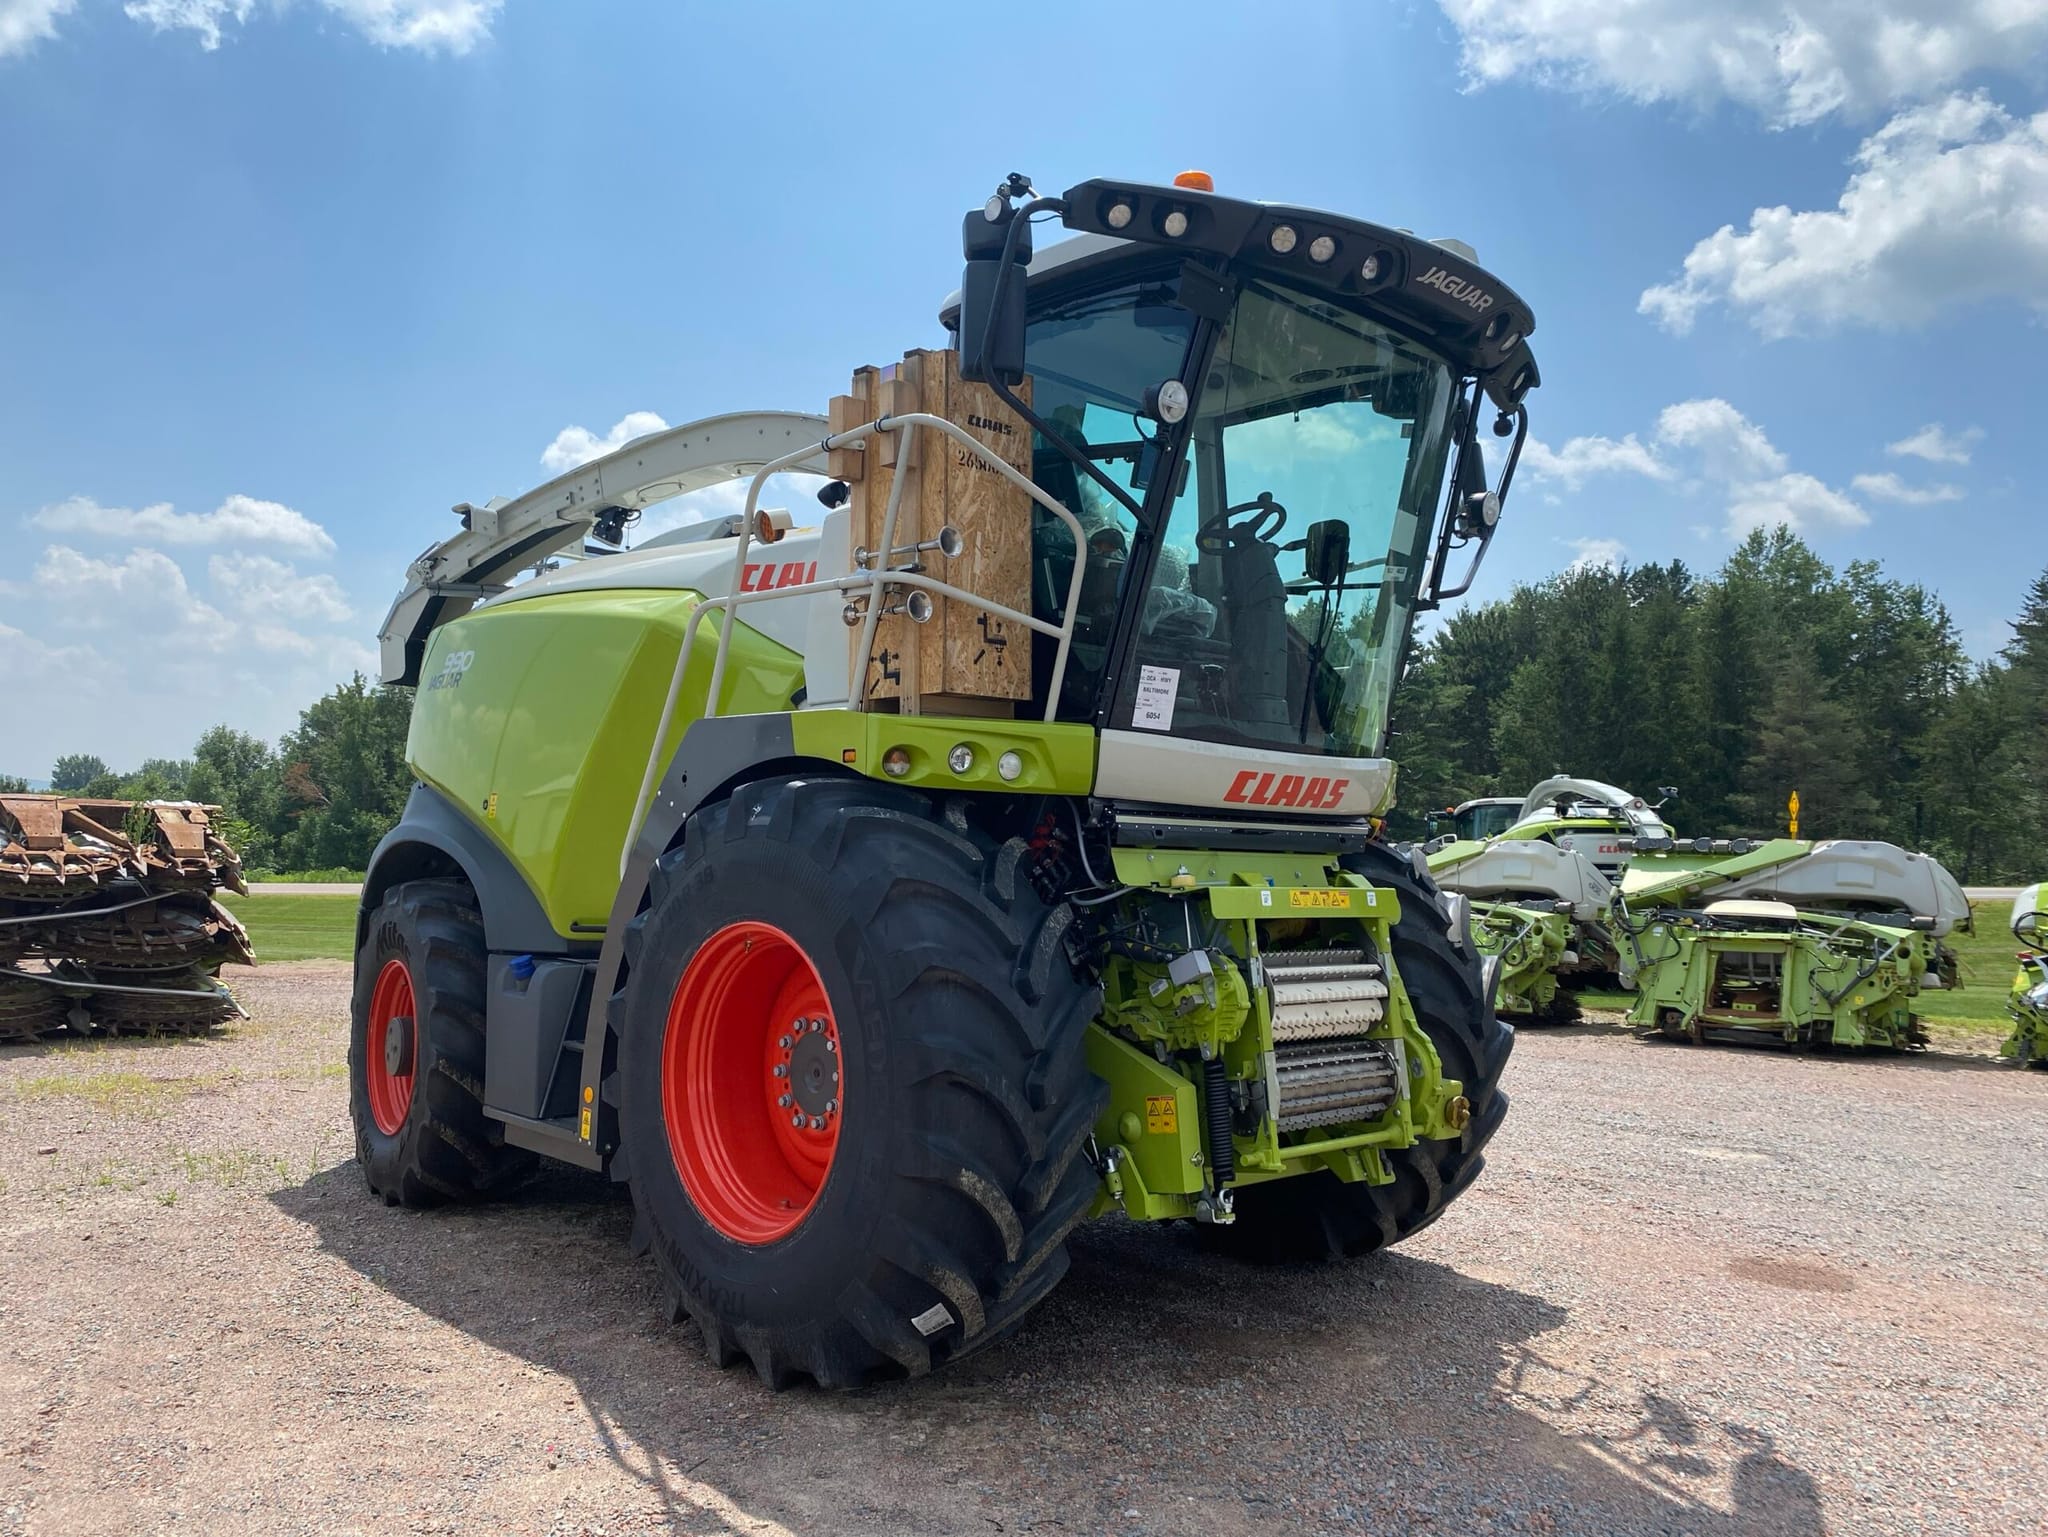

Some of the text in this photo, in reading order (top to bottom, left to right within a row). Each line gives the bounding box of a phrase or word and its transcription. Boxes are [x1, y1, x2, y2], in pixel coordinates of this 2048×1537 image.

[1416, 266, 1494, 313] JAGUAR
[740, 561, 817, 592] CLA
[1145, 711, 1161, 720] 6054
[1223, 770, 1350, 809] CLAAS
[1626, 947, 1633, 955] 5
